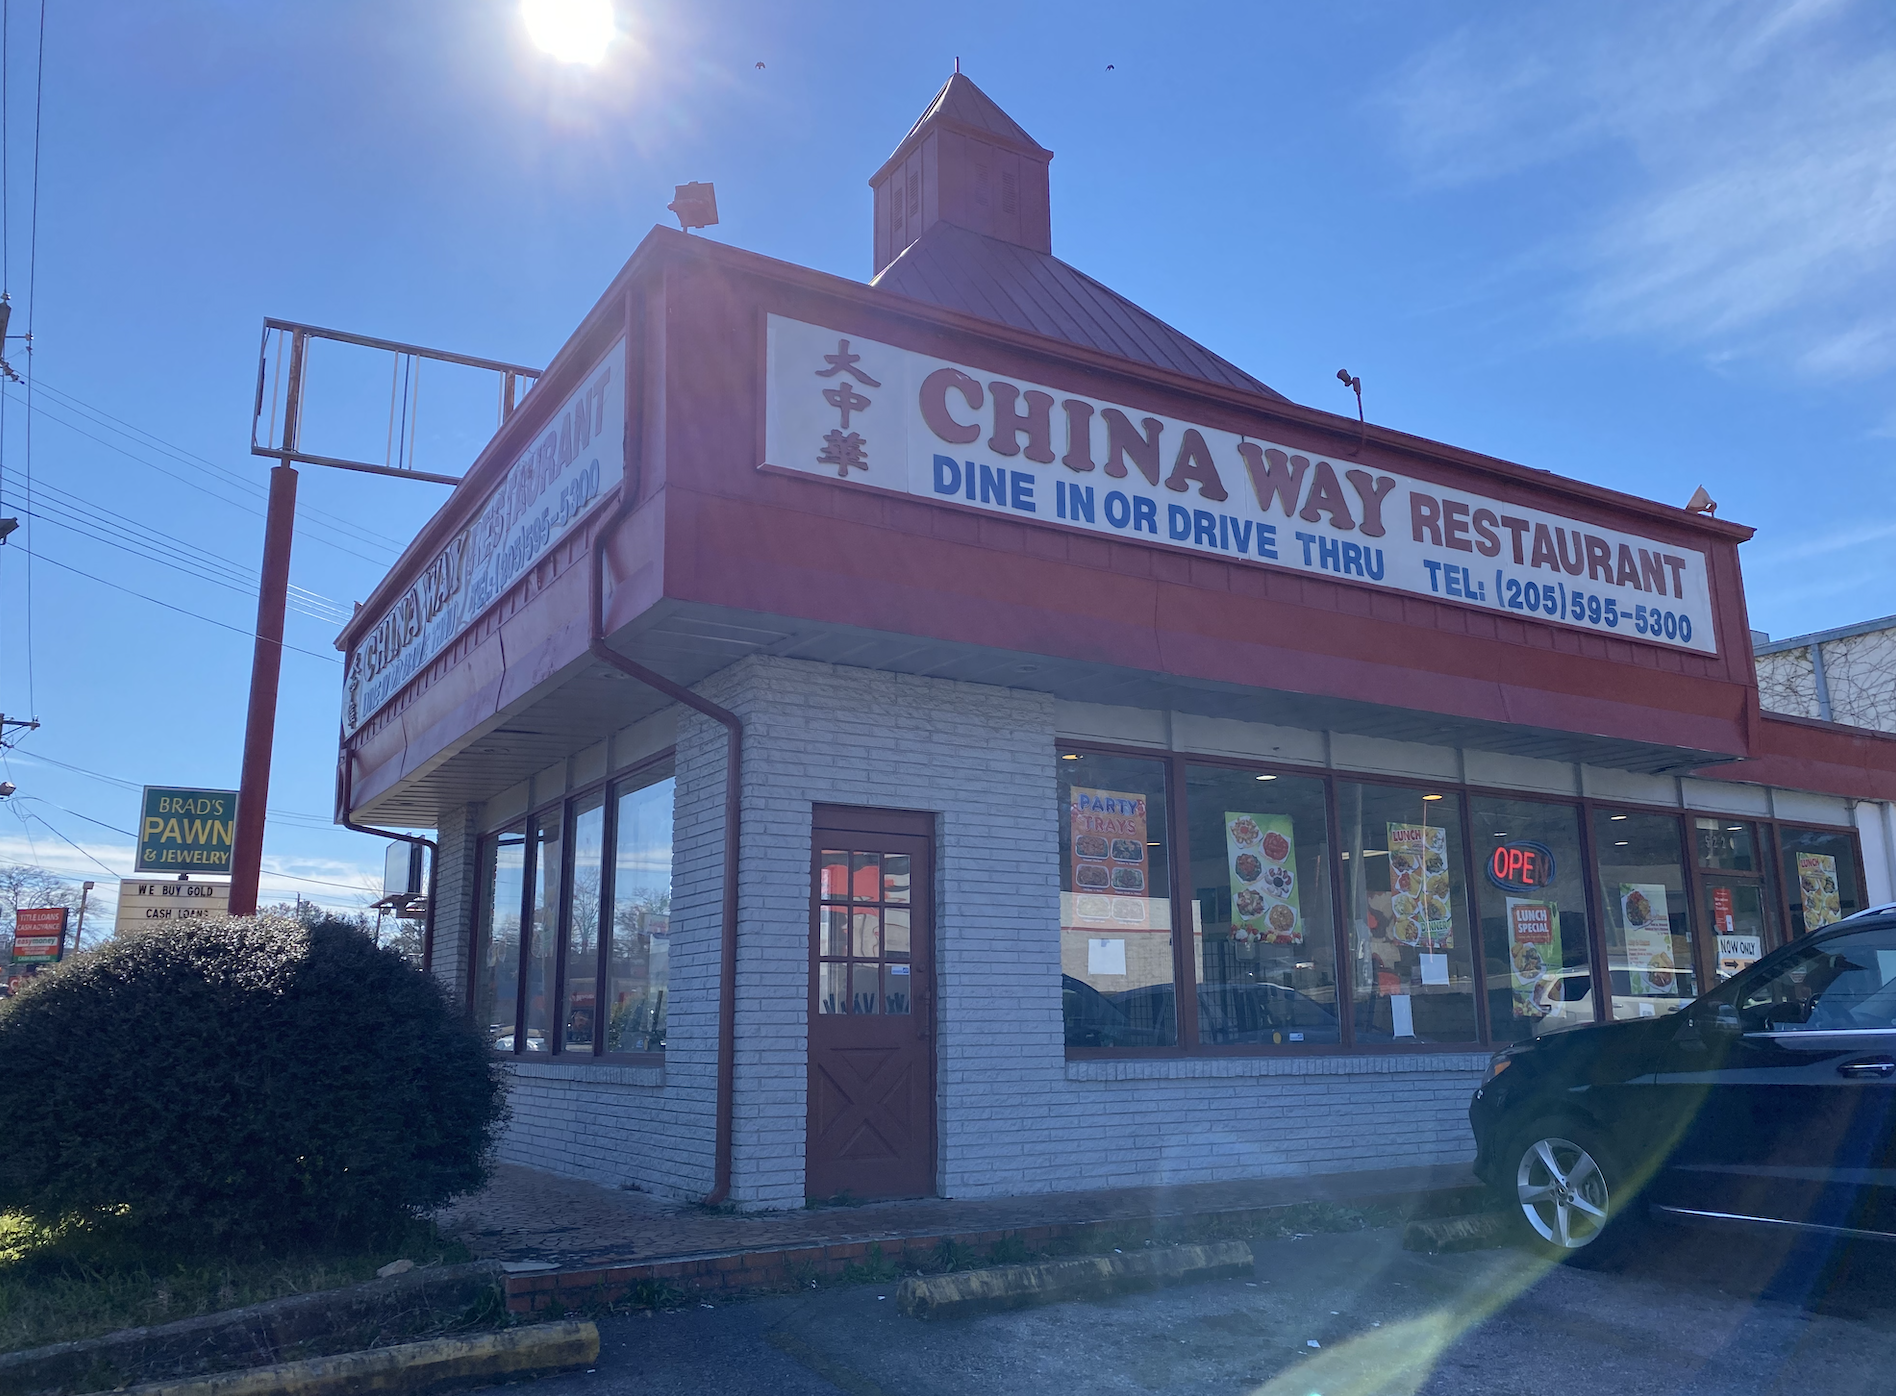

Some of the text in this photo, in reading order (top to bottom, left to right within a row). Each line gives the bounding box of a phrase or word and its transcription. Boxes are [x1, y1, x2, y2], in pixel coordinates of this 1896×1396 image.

[814, 338, 882, 478] 大中華
[918, 366, 1396, 538] CHINA WAY
[467, 366, 611, 576] RESTAURANT
[933, 453, 1386, 582] DINE IN OR DRIVE THRU
[1409, 491, 1687, 600] RESTAURANT
[422, 530, 471, 624] WAY
[1423, 559, 1693, 644] TEL: (205)595-5300
[159, 797, 224, 815] BRAD'S
[1077, 793, 1139, 816] PARTY
[143, 817, 233, 846] PAWN
[1083, 815, 1137, 836] TRAYS
[1393, 829, 1422, 842] LUNCH
[144, 849, 230, 864] & JEWELRY
[1800, 858, 1819, 868] LUNCH
[1494, 846, 1549, 887] OPEN
[138, 885, 213, 897] WE BUY GOLD
[20, 913, 60, 922] TITLE LOANS
[146, 908, 172, 918] CASH
[1516, 909, 1547, 921] LUNCH
[1421, 921, 1448, 932] DINNER
[1517, 923, 1549, 933] SPECIAL
[1720, 938, 1756, 956] NOW ONLY
